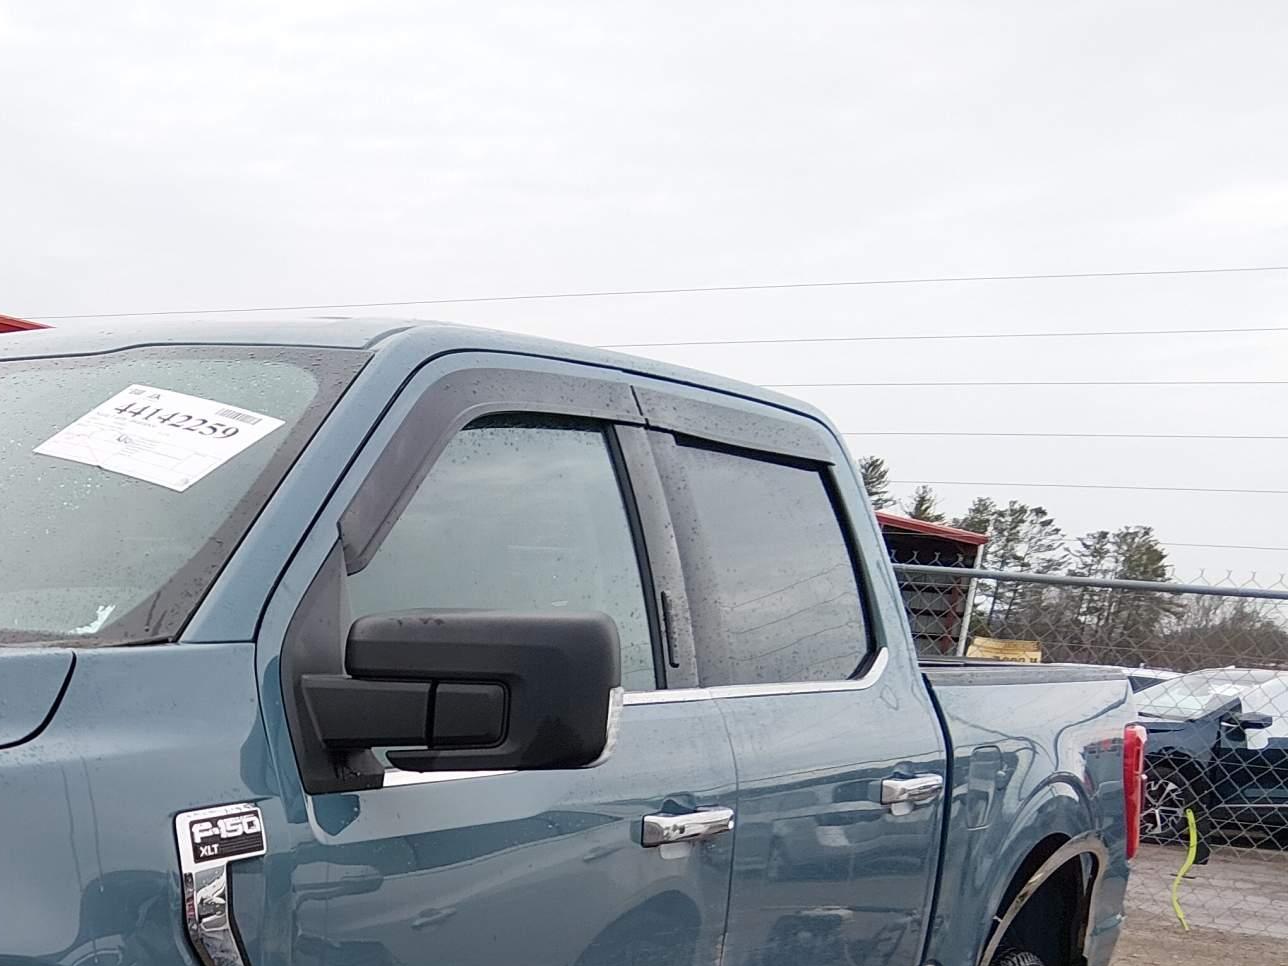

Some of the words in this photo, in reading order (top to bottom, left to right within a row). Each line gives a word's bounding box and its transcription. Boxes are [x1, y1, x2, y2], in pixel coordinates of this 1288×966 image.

[114, 402, 240, 439] 44142259
[192, 815, 261, 843] F-150
[199, 844, 219, 858] XLT
